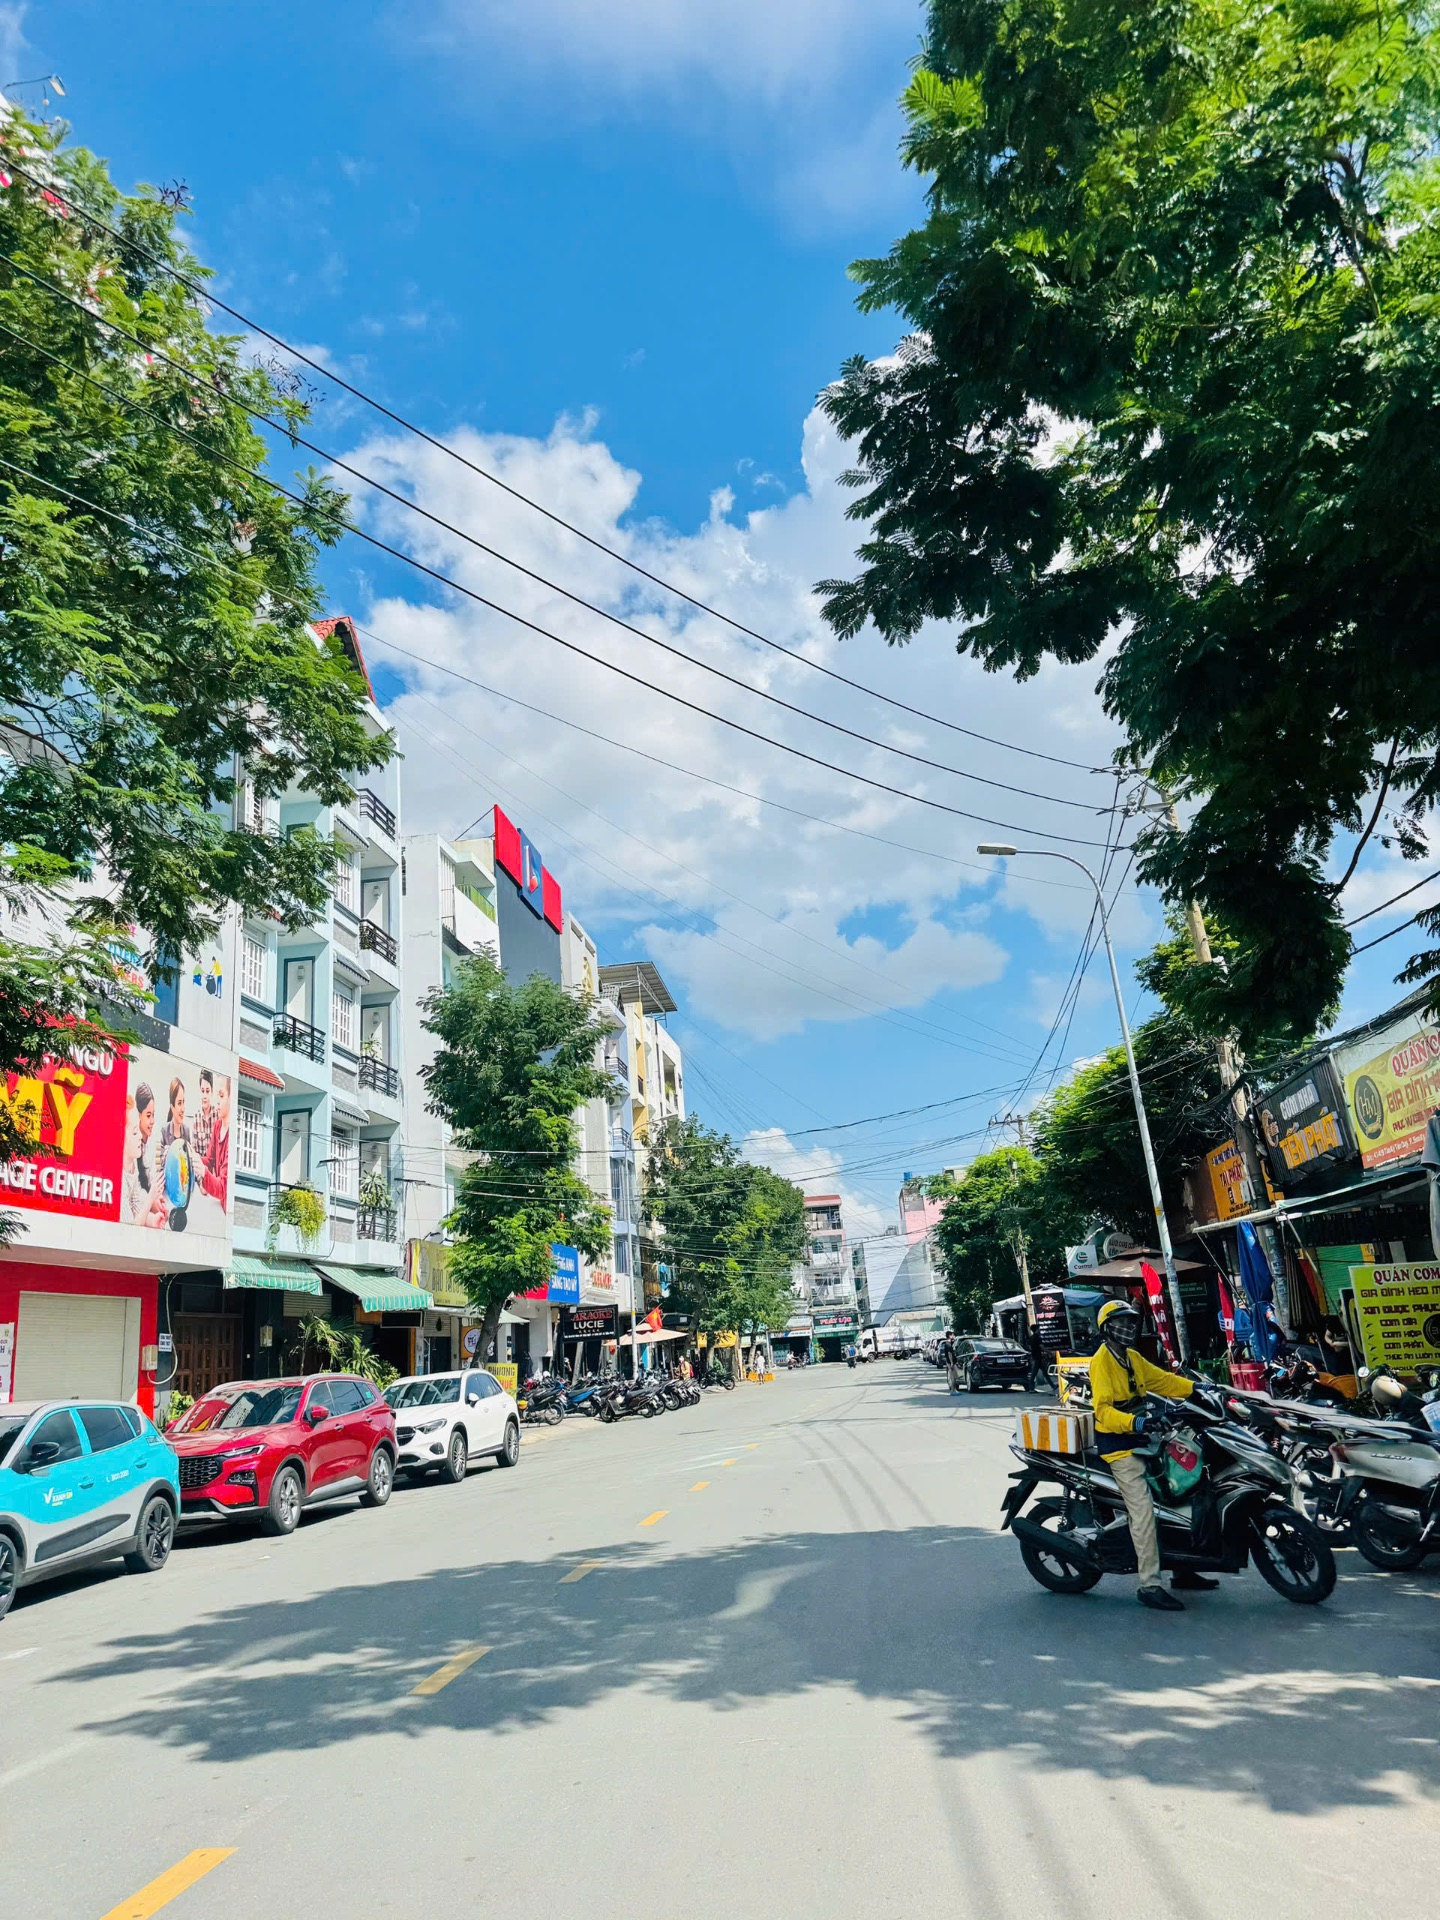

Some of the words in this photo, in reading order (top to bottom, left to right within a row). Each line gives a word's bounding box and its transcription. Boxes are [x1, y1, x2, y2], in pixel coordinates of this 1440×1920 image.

[1391, 1041, 1427, 1078] QUÁN
[40, 1167, 114, 1204] CENTER
[1373, 1266, 1411, 1285] QUÁN
[1413, 1266, 1440, 1281] CƠM
[1360, 1289, 1379, 1298] GIA
[1381, 1287, 1405, 1297] ĐÌNH
[570, 1310, 613, 1321] ARAOKE
[1363, 1306, 1381, 1315] XIN
[573, 1320, 605, 1330] LUCIE
